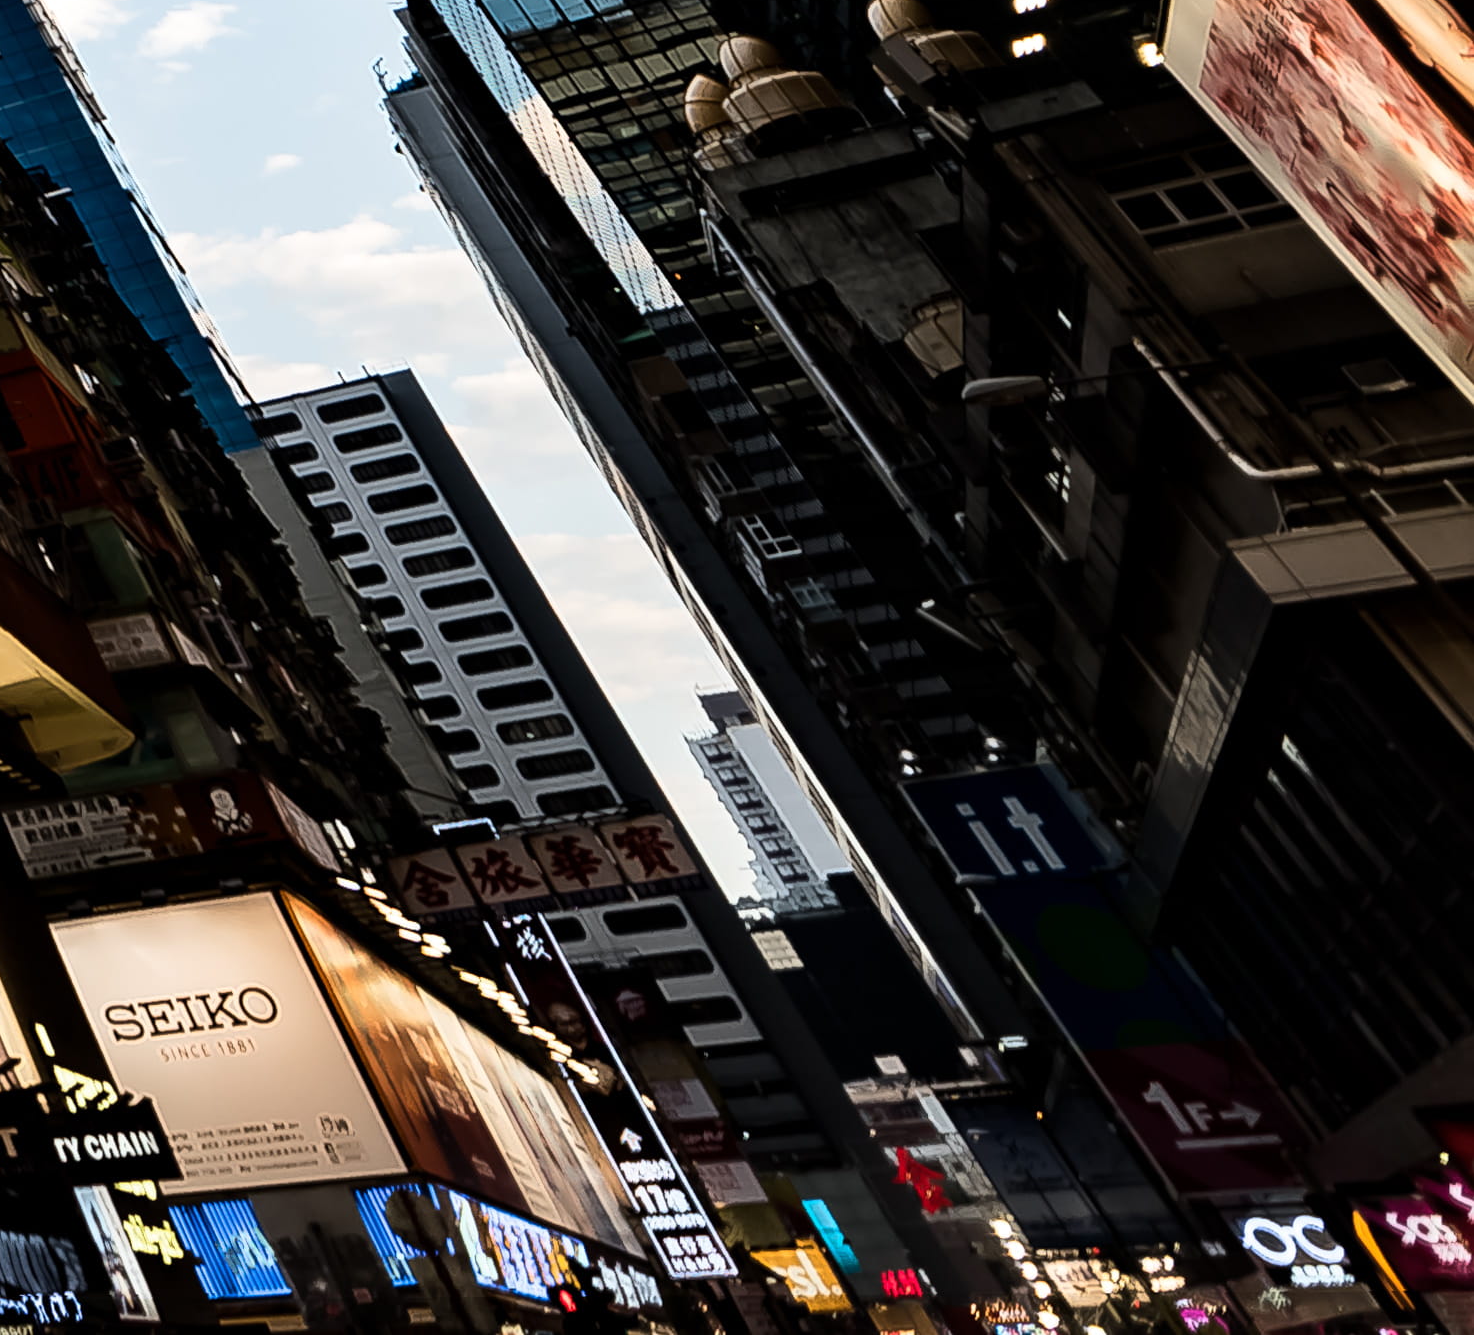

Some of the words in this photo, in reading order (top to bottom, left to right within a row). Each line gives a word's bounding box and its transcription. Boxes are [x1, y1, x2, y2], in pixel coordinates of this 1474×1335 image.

[102, 985, 279, 1044] SEIKO
[159, 1044, 210, 1063] SINCE
[217, 1036, 257, 1057] 1881
[83, 1129, 160, 1163] CHAIN
